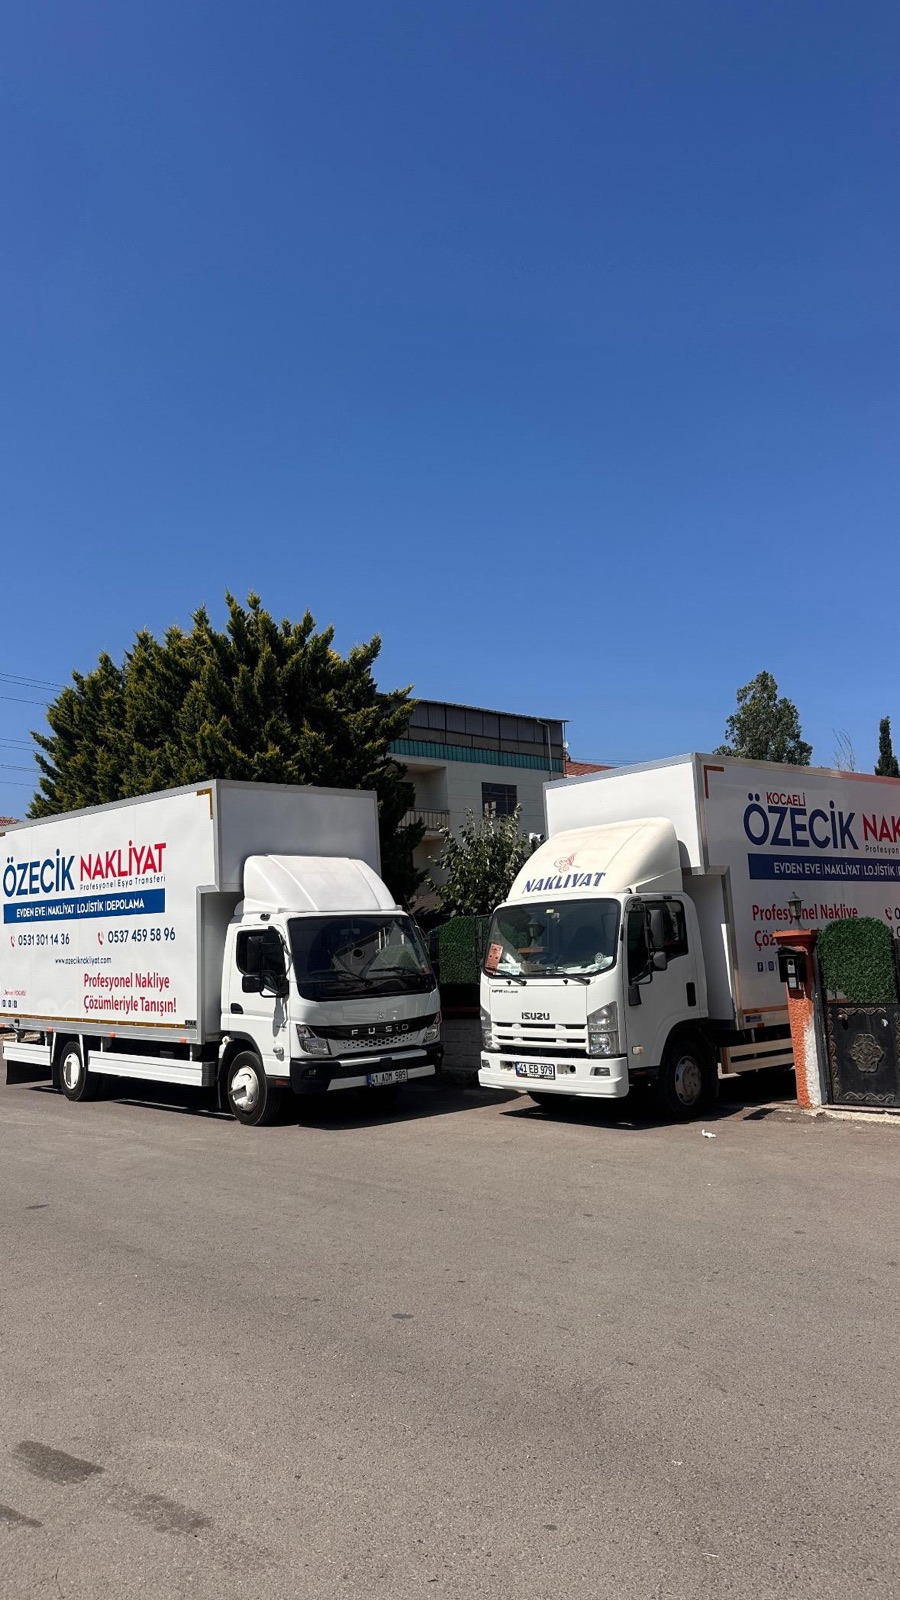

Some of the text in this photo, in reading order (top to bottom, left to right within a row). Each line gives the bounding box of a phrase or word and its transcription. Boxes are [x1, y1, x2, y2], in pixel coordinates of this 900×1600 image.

[767, 792, 806, 807] KOCAELİ
[743, 792, 859, 850] ÖZECİK
[3, 840, 166, 897] ÖZECİK NAKLİYAT
[774, 861, 895, 876] EVDEN EVE NAKLİYAT LOJİSTİK
[135, 873, 166, 885] Transferi
[17, 897, 145, 918] EVDEN EVE NAKLİYAT LOJİSTİK DEPOLAMA
[752, 904, 818, 924] Profesynel
[18, 933, 70, 946] 0531 301 14 36
[108, 927, 176, 943] 0537 459 58 96
[84, 972, 170, 992] Profesyonel Nakliye
[84, 995, 177, 1017] Çözümleriyle Tanışın!
[521, 1012, 550, 1021] ISUZU
[520, 1063, 553, 1075] 41 EB 979
